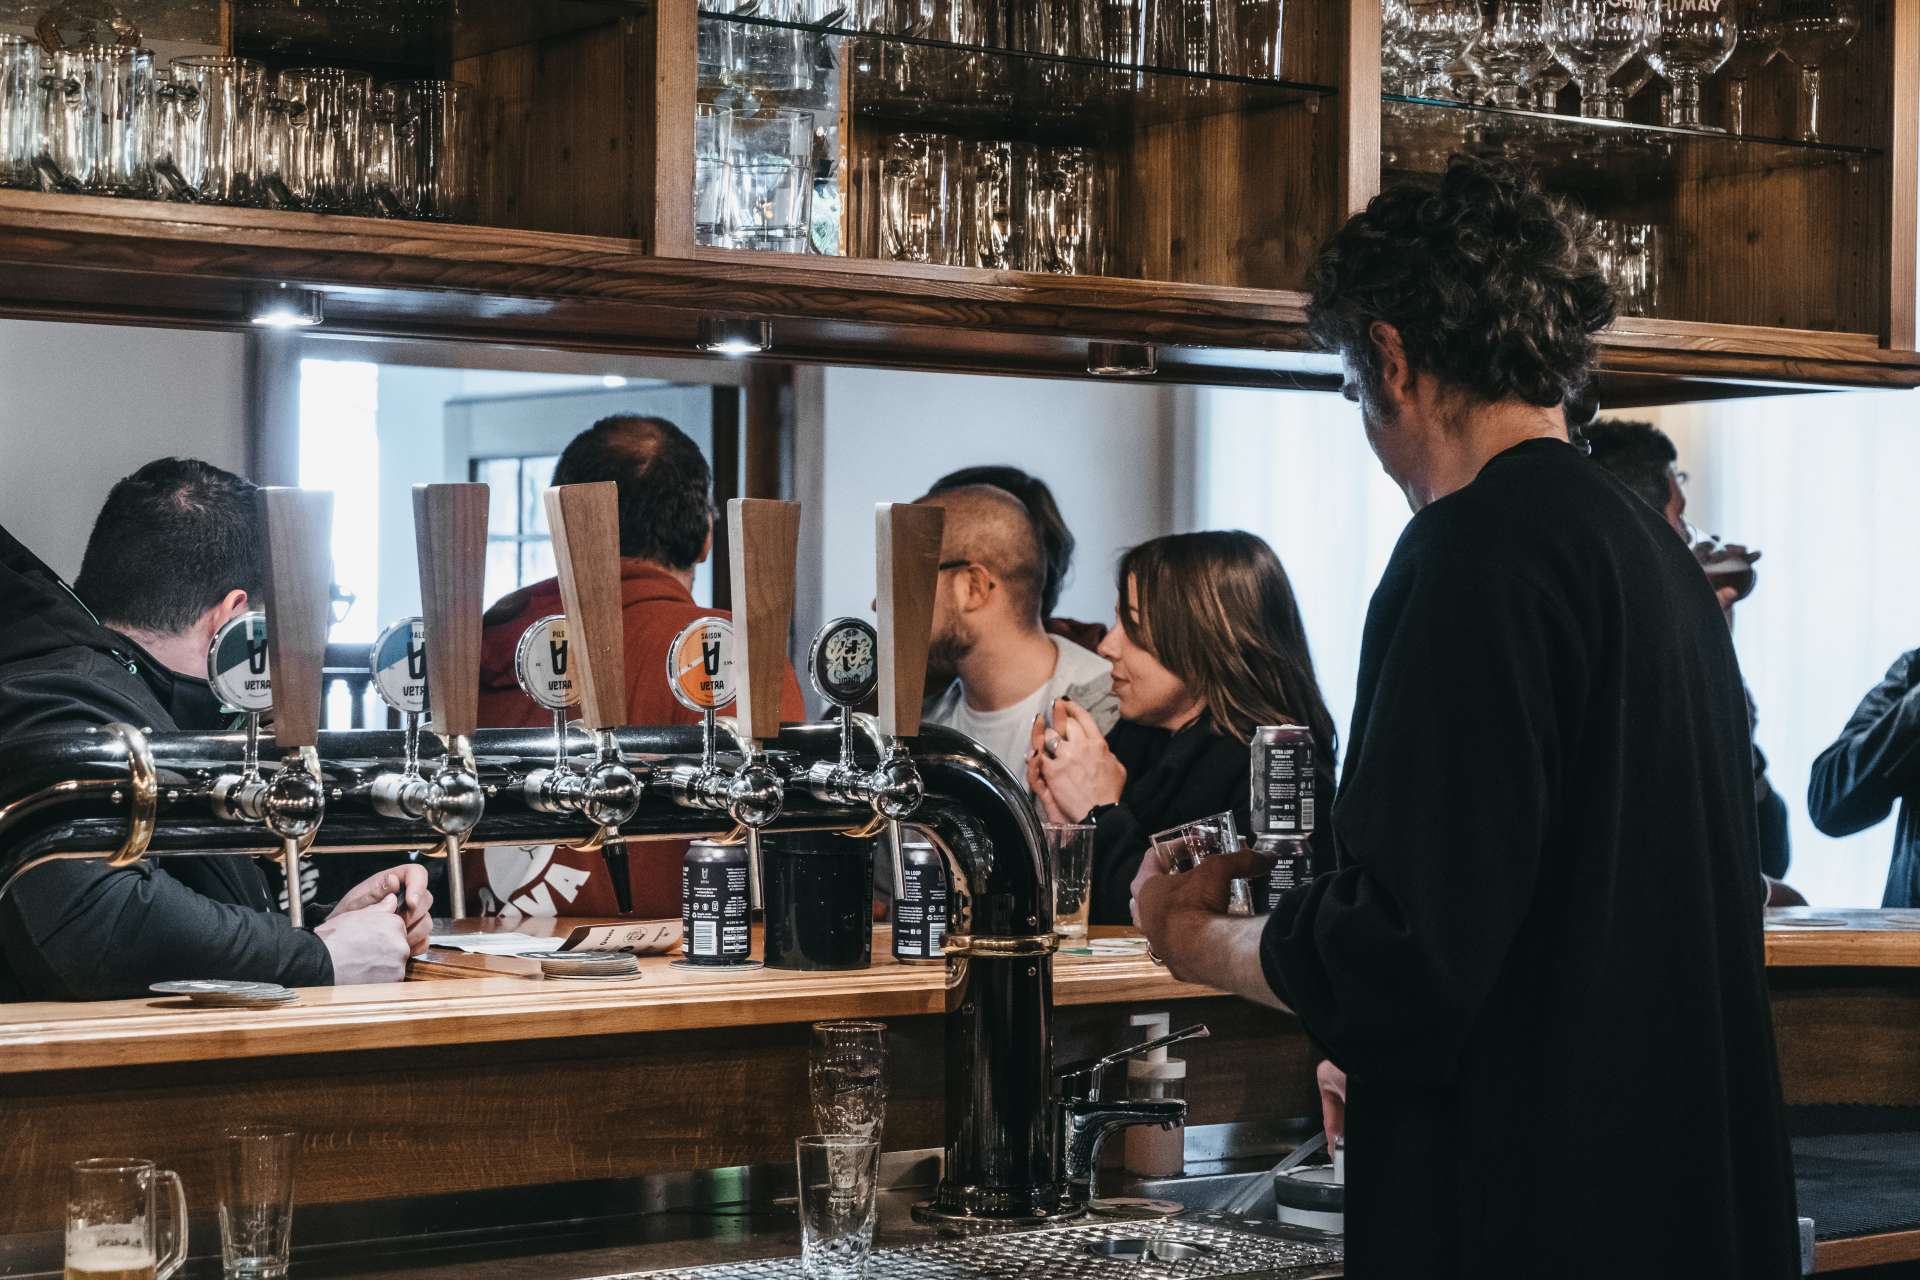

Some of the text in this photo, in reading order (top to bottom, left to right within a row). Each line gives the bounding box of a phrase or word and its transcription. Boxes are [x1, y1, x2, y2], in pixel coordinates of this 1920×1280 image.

[552, 630, 565, 638] PILS
[701, 632, 722, 640] SAISON
[403, 686, 425, 696] VETR
